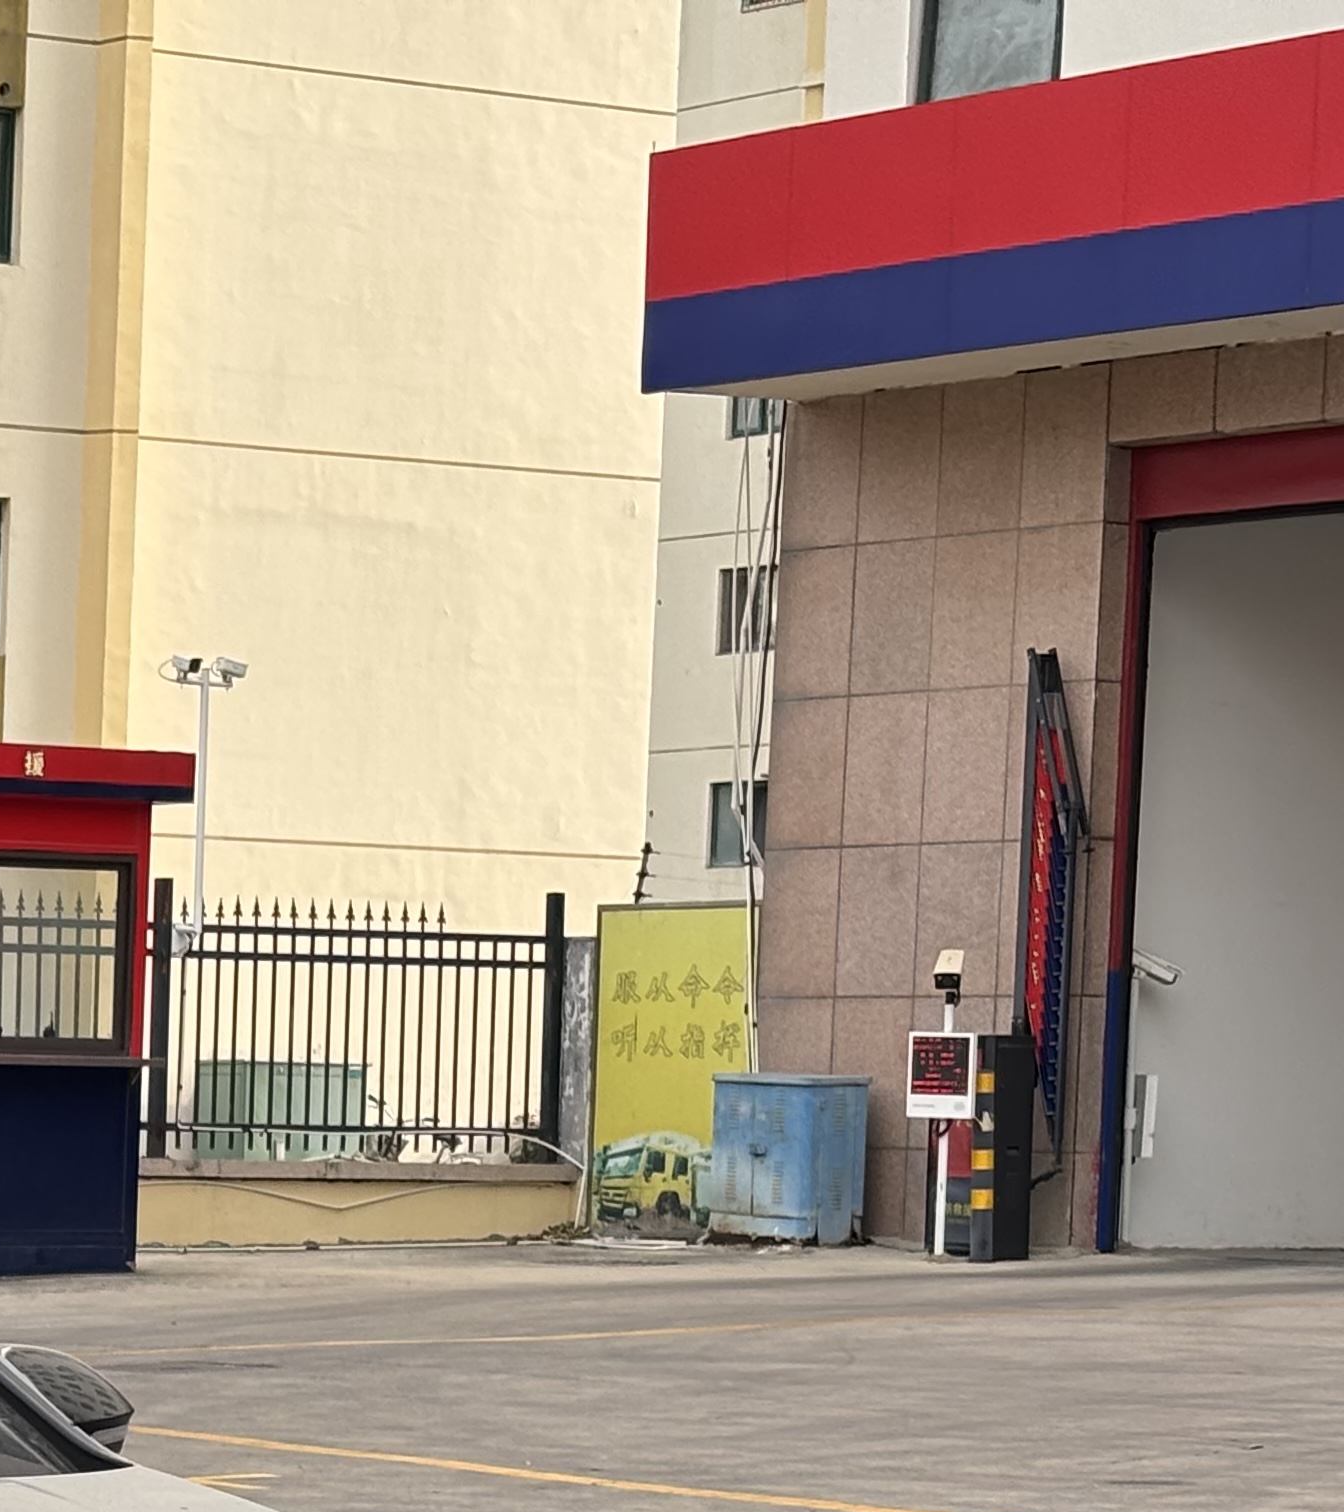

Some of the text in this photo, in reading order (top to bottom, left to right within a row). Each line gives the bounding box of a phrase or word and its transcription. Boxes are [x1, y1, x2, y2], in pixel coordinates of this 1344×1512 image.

[611, 963, 745, 1009] 服从命令
[610, 1016, 741, 1063] 听从指挥
